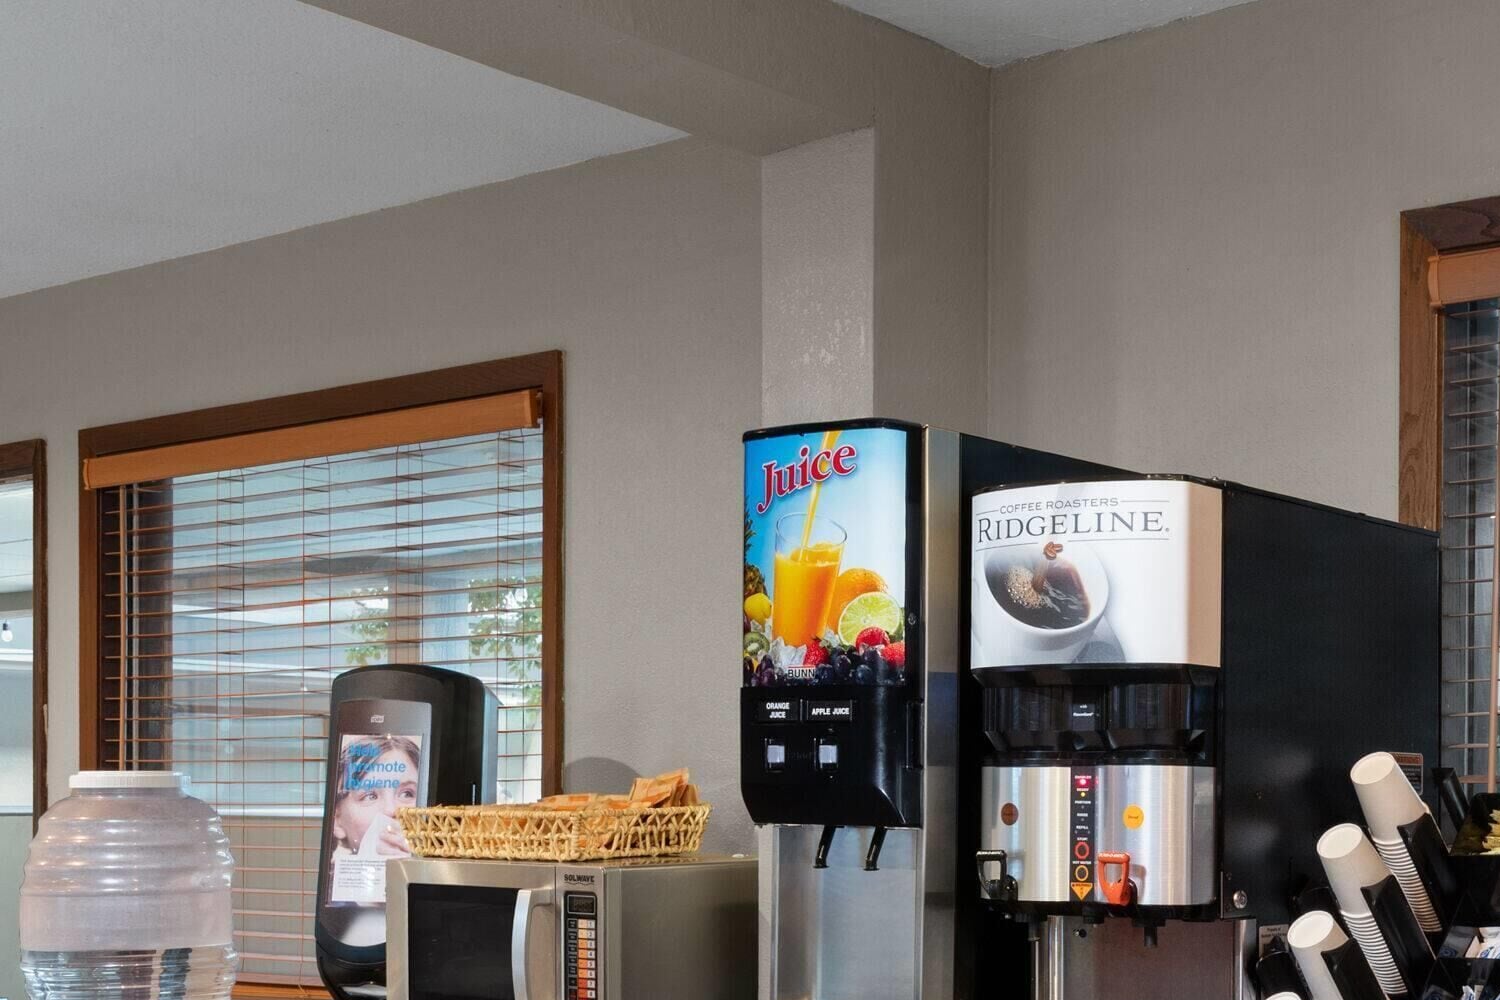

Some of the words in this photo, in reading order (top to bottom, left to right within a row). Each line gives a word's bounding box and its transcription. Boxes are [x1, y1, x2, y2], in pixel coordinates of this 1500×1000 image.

[757, 445, 857, 513] Juice
[1000, 501, 1042, 515] COFFEE
[1046, 497, 1119, 510] ROASTERS
[787, 668, 815, 679] BUNN
[766, 702, 790, 710] ORANGE
[811, 708, 831, 716] APPLE
[832, 707, 850, 715] JUICE
[769, 711, 786, 719] JUICE
[348, 760, 407, 776] promote
[346, 776, 401, 791] hygiene
[564, 873, 595, 883] SOLWAVE
